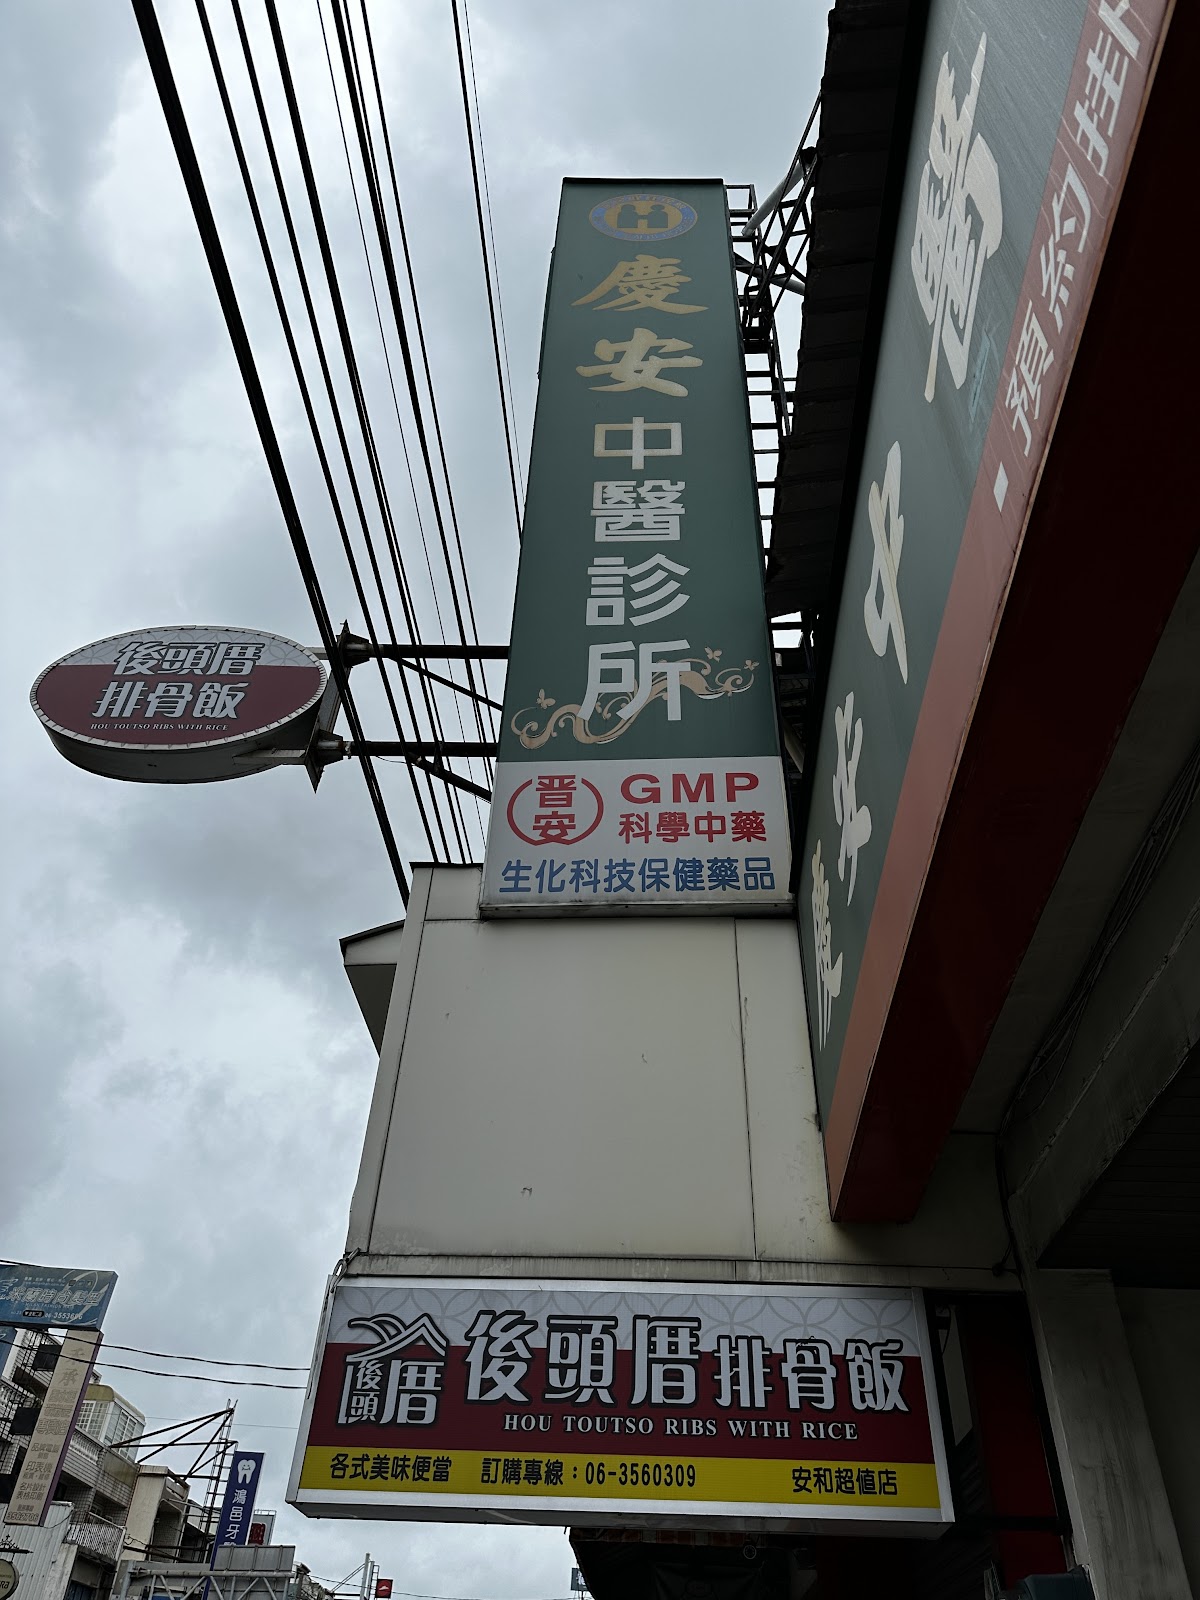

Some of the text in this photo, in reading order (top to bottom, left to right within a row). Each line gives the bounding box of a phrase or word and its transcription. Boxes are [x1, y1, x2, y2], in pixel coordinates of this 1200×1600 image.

[570, 253, 710, 721] 慶安中醫診所
[113, 641, 265, 675] 後頭厝
[92, 681, 249, 719] 排骨飯
[620, 772, 760, 804] GMP
[618, 810, 767, 843] 科學中藥
[499, 857, 776, 893] 生化科技保健藥品
[504, 1414, 858, 1441] HOU TOUTSO RIBS WITH RICE
[330, 1453, 452, 1482] 各式美味便當
[792, 1466, 898, 1495] 安和超值店
[223, 1489, 247, 1546] 鴻邑牙
